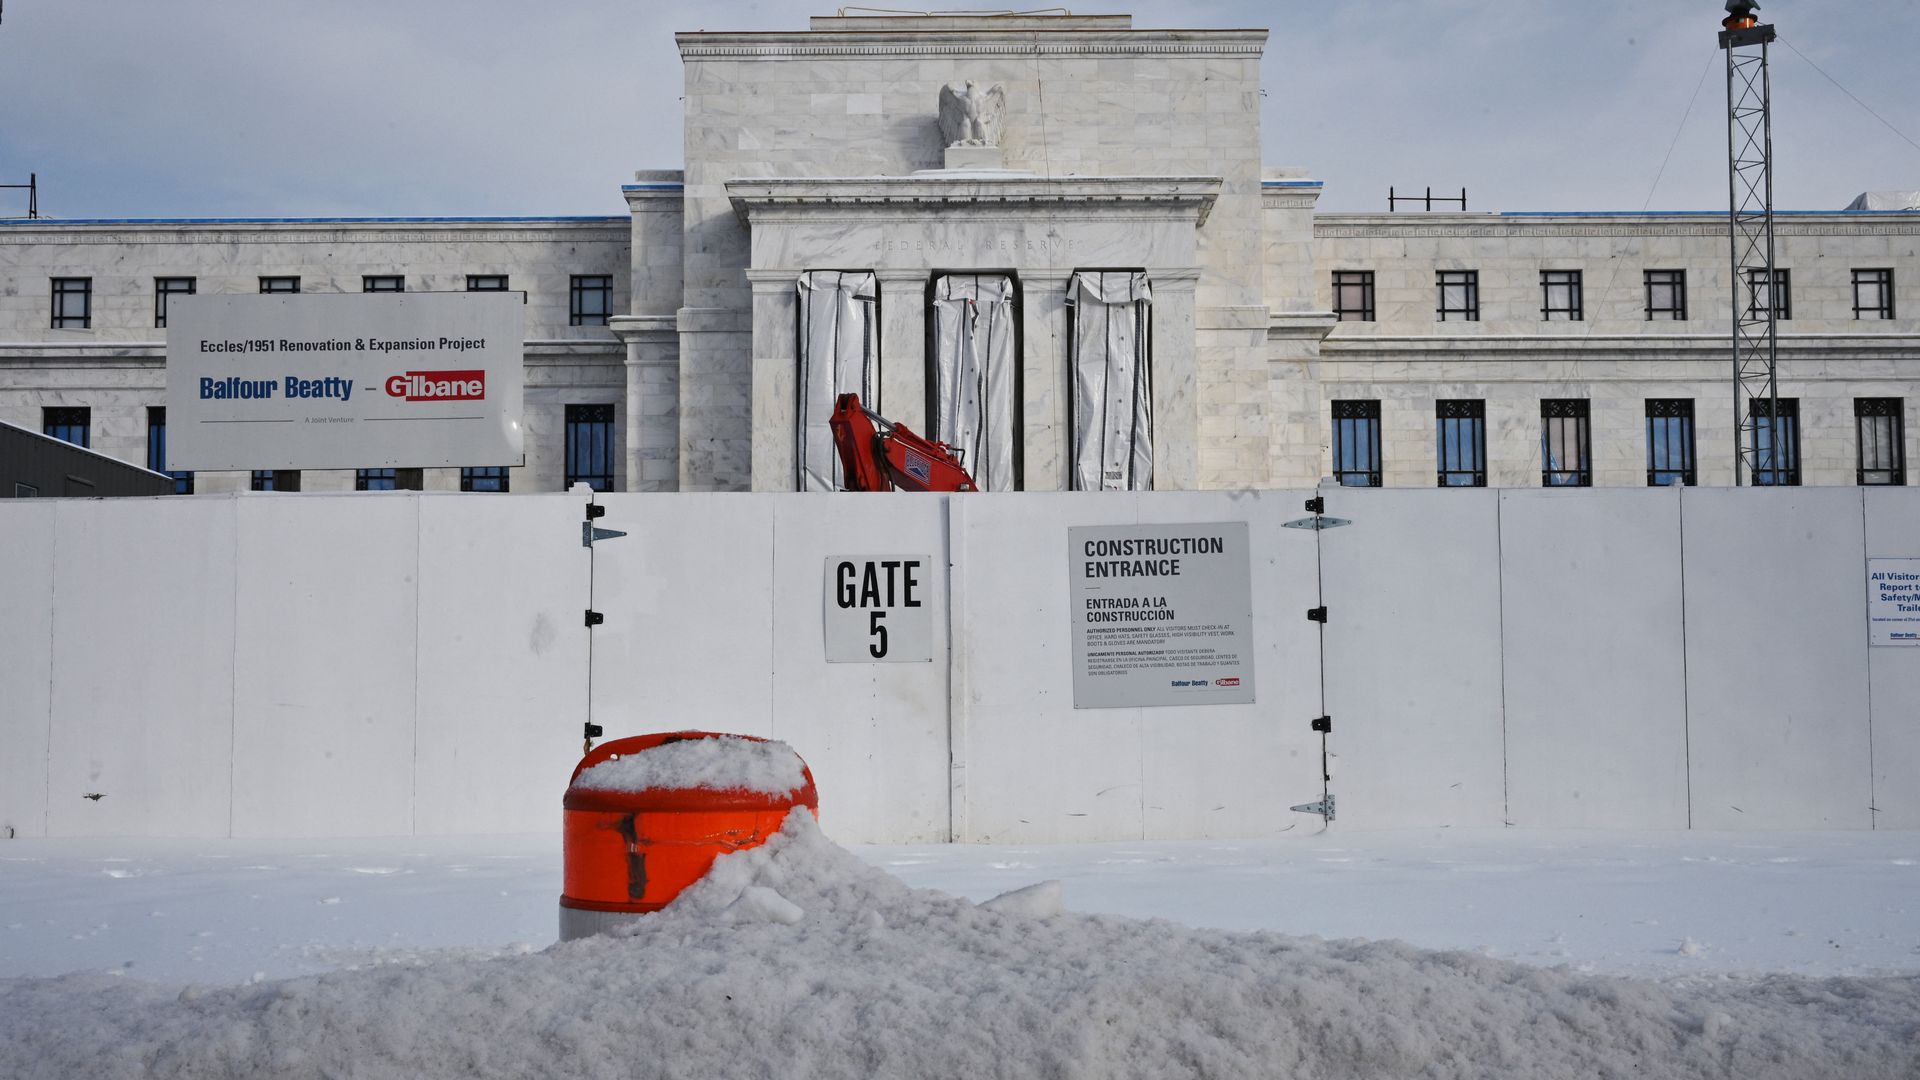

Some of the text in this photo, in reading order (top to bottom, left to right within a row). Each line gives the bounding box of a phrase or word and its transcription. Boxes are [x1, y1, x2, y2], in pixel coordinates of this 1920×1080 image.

[985, 239, 1074, 250] RESERVE
[200, 337, 485, 353] Eccles/1951 Renovation & Expansion Project
[200, 375, 484, 401] Balfour Beatty Gilbane
[1084, 537, 1223, 557] CONSTRUCTION
[1085, 559, 1181, 578] ENTRANCE
[1871, 572, 1920, 580] All Visitor
[837, 560, 921, 609] GATE
[1879, 583, 1912, 592] Report
[1086, 597, 1167, 609] ENTRADA A LA
[1086, 608, 1175, 622] CONSTRUCCIÓN
[869, 611, 888, 659] 5
[1191, 679, 1208, 687] Beatty
[1215, 678, 1240, 687] Gilbane
